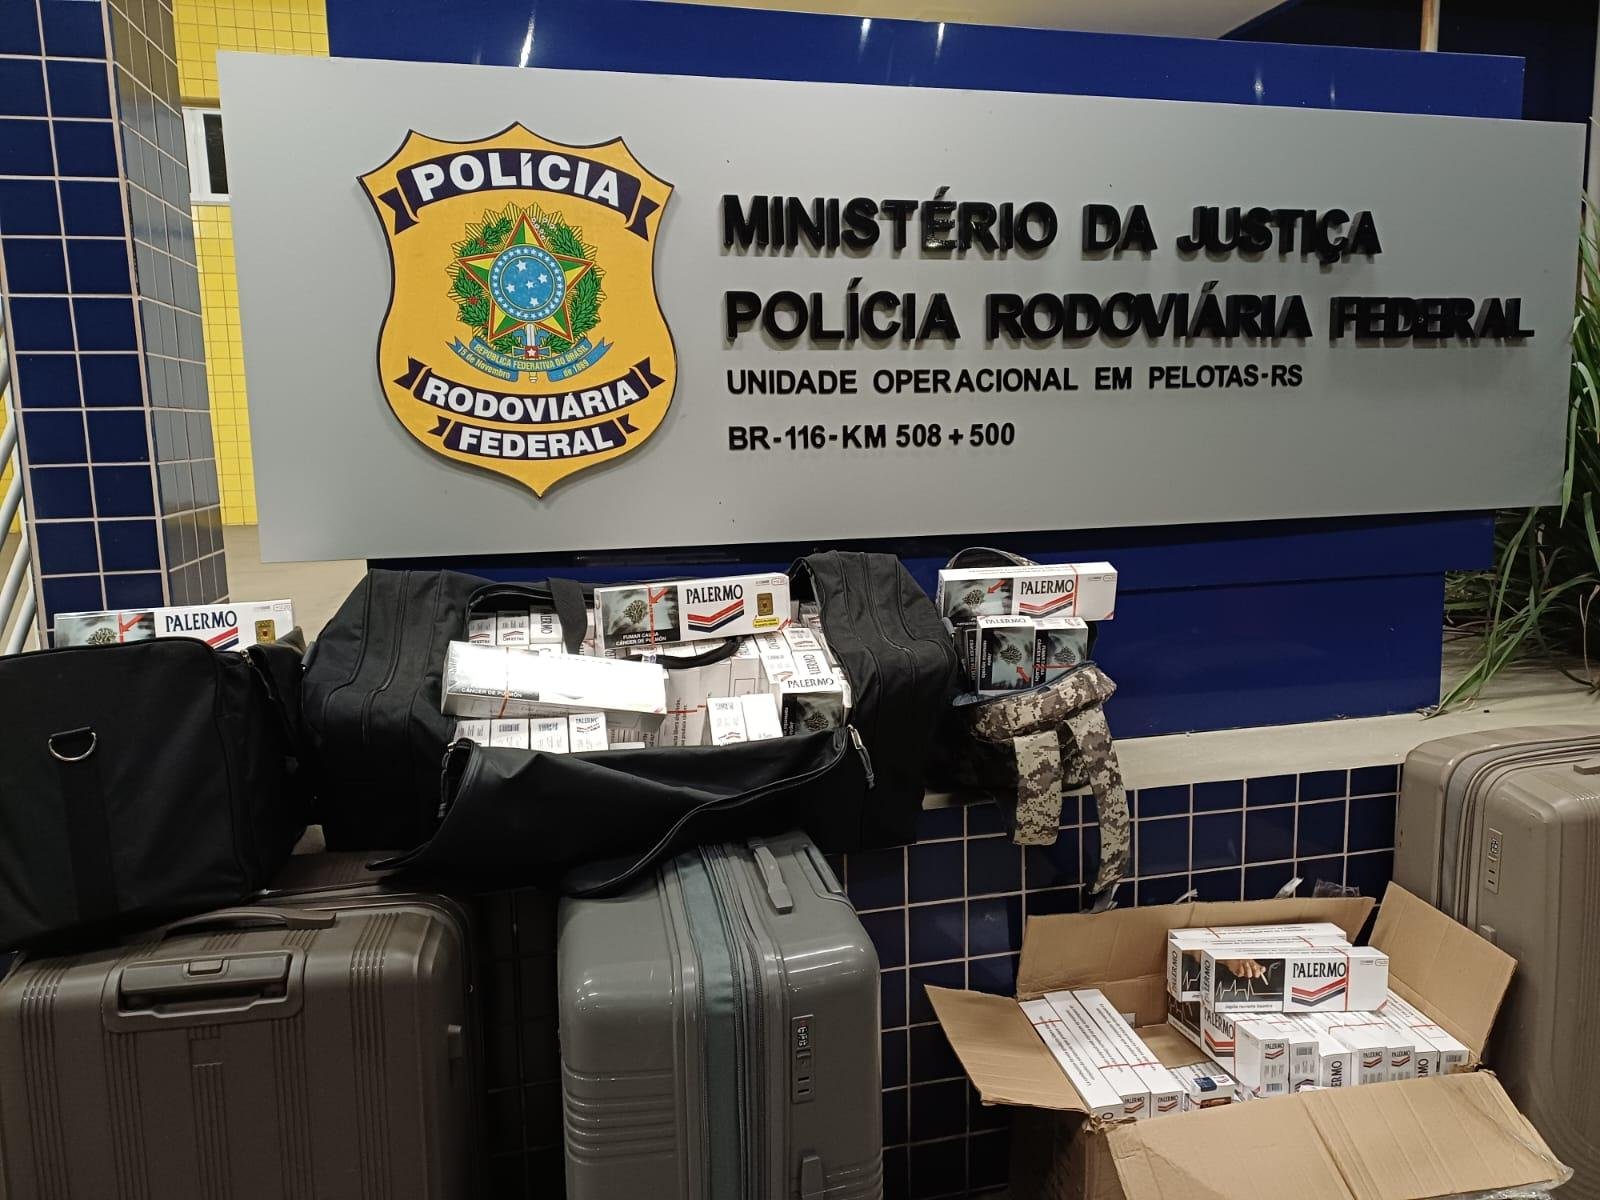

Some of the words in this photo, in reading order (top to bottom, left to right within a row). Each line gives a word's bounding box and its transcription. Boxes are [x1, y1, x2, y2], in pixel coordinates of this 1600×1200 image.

[411, 152, 620, 207] POLÍCIA
[721, 185, 1058, 251] MINISTÉRIO
[1083, 203, 1158, 252] DA
[1176, 206, 1382, 263] JUSTIÇA
[724, 276, 961, 341] POLÍCIA
[985, 280, 1313, 341] RODOVIÁRIA
[1330, 296, 1535, 340] FEDERAL
[466, 352, 475, 364] de
[475, 358, 511, 379] Novembro
[513, 359, 556, 371] FEDERATIVA
[566, 344, 589, 364] BRASIL
[727, 369, 858, 395] UNIDADE
[873, 367, 1078, 394] OPERACIONAL
[1095, 366, 1132, 391] EM
[1149, 364, 1303, 389] PELOTAS-RS
[422, 376, 640, 424] RODOVIÁRIA
[458, 426, 614, 458] FEDERAL
[896, 423, 942, 448] 508
[969, 422, 1015, 447] 500
[686, 584, 744, 605] PALERMO
[1020, 579, 1074, 595] PALERMO
[165, 610, 238, 632] PALERMO
[985, 617, 1027, 625] PALERMO
[787, 678, 834, 688] PALERMO
[1293, 962, 1346, 978] PALERMO
[1204, 1007, 1234, 1040] PALERMO
